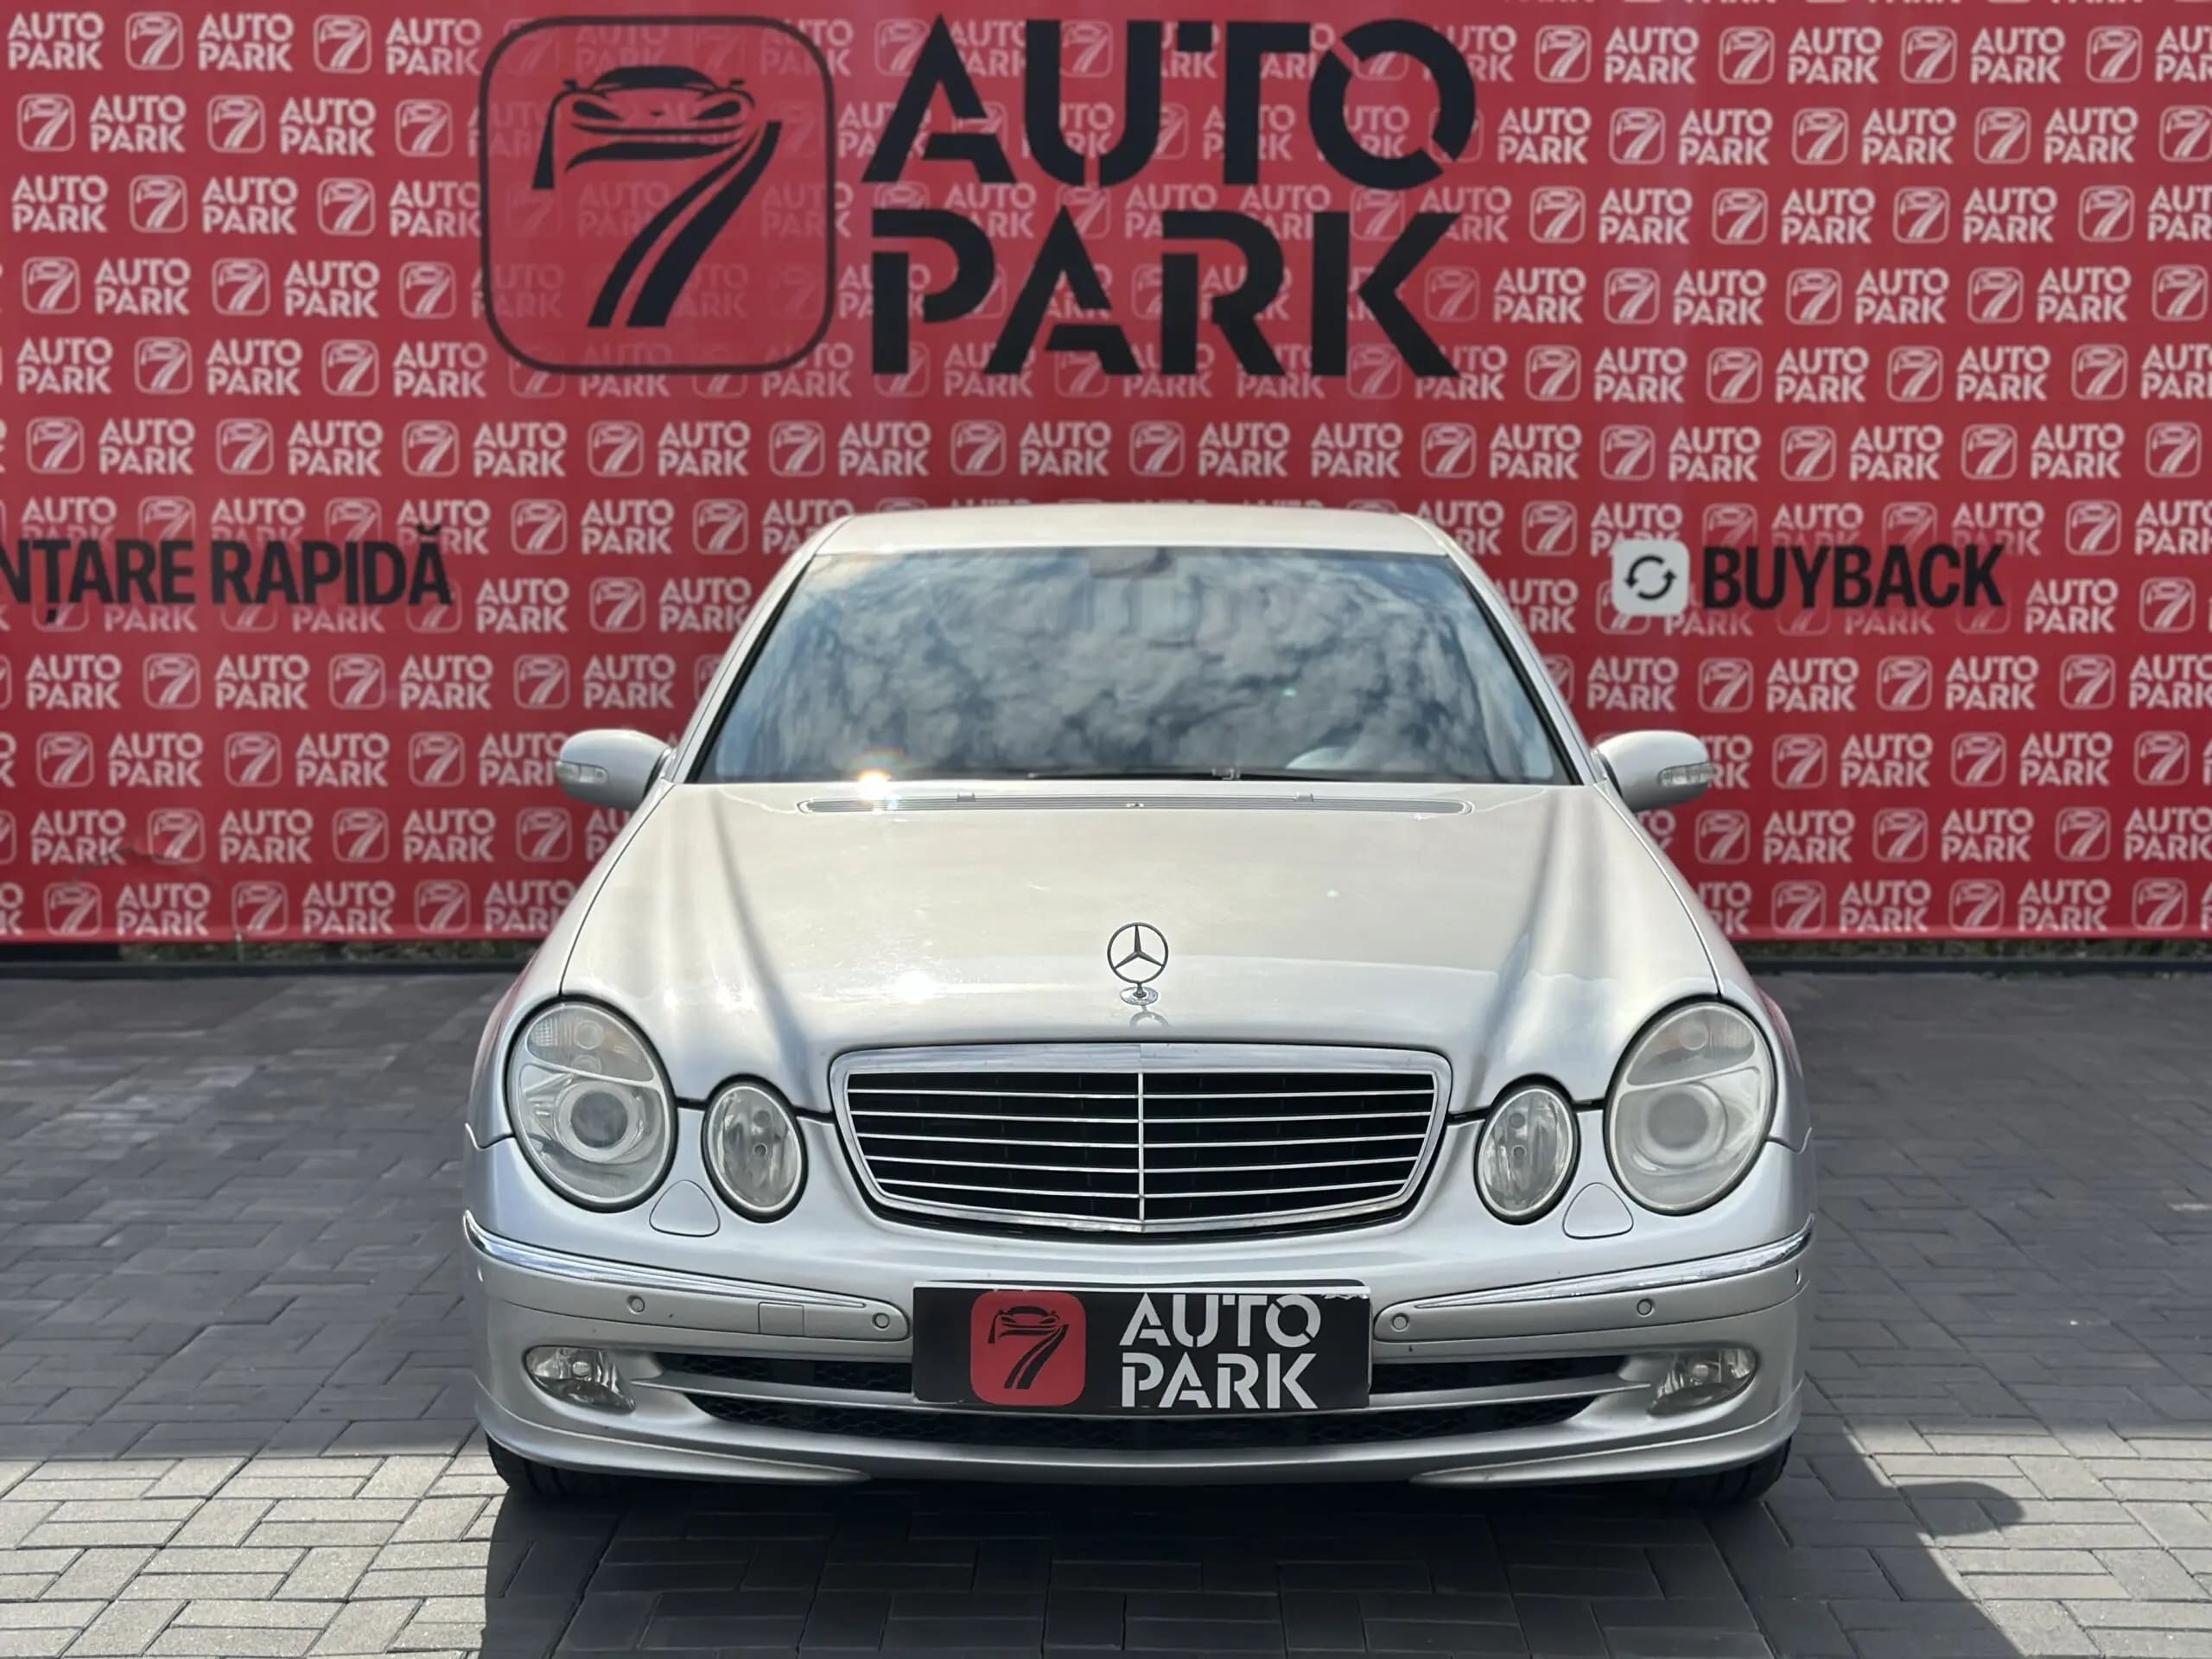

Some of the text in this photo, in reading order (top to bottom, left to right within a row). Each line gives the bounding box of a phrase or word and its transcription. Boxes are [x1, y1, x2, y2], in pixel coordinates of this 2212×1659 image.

[8, 12, 104, 41] AUTO
[198, 14, 294, 41] AUTO
[386, 18, 481, 46] AUTO
[1605, 27, 1700, 54] AUTO
[1789, 27, 1883, 54] AUTO
[1972, 27, 2065, 54] AUTO
[9, 41, 102, 69] PARK
[199, 41, 292, 71] PARK
[386, 46, 478, 74] PARK
[1605, 54, 1695, 84] PARK
[1788, 54, 1878, 83] PARK
[1971, 54, 2061, 83] PARK
[90, 95, 187, 123] AUTO
[280, 97, 376, 124] AUTO
[861, 14, 1477, 191] AUTO
[1498, 107, 1591, 135] AUTO
[1680, 109, 1773, 136] AUTO
[1862, 108, 1956, 136] AUTO
[2045, 106, 2139, 134] AUTO
[91, 123, 184, 152] PARK
[281, 124, 373, 156] PARK
[1498, 135, 1587, 163] PARK
[1679, 136, 1768, 165] PARK
[1862, 136, 1953, 164] PARK
[2044, 134, 2134, 163] PARK
[12, 175, 108, 203] AUTO
[202, 177, 298, 204] AUTO
[390, 181, 480, 208] AUTO
[944, 183, 1036, 210] AUTO
[1599, 188, 1693, 215] AUTO
[1783, 188, 1875, 215] AUTO
[1964, 187, 2057, 214] AUTO
[13, 203, 106, 232] PARK
[203, 204, 296, 234] PARK
[390, 208, 480, 237] PARK
[1599, 215, 1688, 244] PARK
[1782, 215, 1872, 244] PARK
[1963, 214, 2053, 243] PARK
[95, 258, 190, 285] AUTO
[284, 261, 380, 288] AUTO
[1495, 268, 1586, 295] AUTO
[1674, 270, 1766, 296] AUTO
[1856, 268, 1949, 295] AUTO
[2038, 266, 2132, 294] AUTO
[95, 285, 189, 315] PARK
[285, 288, 378, 318] PARK
[872, 205, 1461, 378] PARK
[1494, 295, 1582, 323] PARK
[1673, 296, 1762, 325] PARK
[1855, 295, 1945, 323] PARK
[2037, 294, 2126, 322] PARK
[16, 337, 113, 365] AUTO
[207, 339, 302, 365] AUTO
[393, 341, 487, 369] AUTO
[1595, 347, 1688, 373] AUTO
[1777, 346, 1870, 374] AUTO
[1957, 346, 2050, 372] AUTO
[17, 365, 111, 394] PARK
[207, 365, 300, 396] PARK
[394, 369, 485, 397] PARK
[1594, 373, 1683, 403] PARK
[1776, 374, 1865, 403] PARK
[1956, 372, 2046, 401] PARK
[99, 418, 195, 445] AUTO
[288, 421, 383, 447] AUTO
[474, 422, 567, 448] AUTO
[658, 422, 750, 448] AUTO
[839, 422, 931, 448] AUTO
[1020, 422, 1111, 448] AUTO
[1198, 423, 1290, 448] AUTO
[1312, 423, 1402, 449] AUTO
[1491, 424, 1582, 450] AUTO
[1669, 427, 1761, 453] AUTO
[1850, 425, 1943, 452] AUTO
[2032, 423, 2125, 450] AUTO
[99, 445, 193, 474] PARK
[289, 447, 380, 476] PARK
[474, 448, 564, 477] PARK
[658, 448, 747, 476] PARK
[839, 448, 927, 476] PARK
[1020, 448, 1108, 475] PARK
[1198, 448, 1287, 476] PARK
[1312, 449, 1400, 477] PARK
[1490, 450, 1578, 479] PARK
[1669, 453, 1758, 481] PARK
[1850, 452, 1939, 480] PARK
[2031, 450, 2120, 479] PARK
[22, 497, 117, 524] AUTO
[211, 498, 306, 525] AUTO
[397, 499, 491, 526] AUTO
[581, 499, 674, 525] AUTO
[1953, 501, 2044, 529] AUTO
[582, 525, 671, 554] PARK
[212, 524, 452, 606] RAPIDĂ
[1703, 543, 2005, 609] BUYBACK
[476, 578, 569, 605] AUTO
[2027, 578, 2119, 606] AUTO
[105, 605, 194, 632] PARK
[292, 606, 385, 632] PARK
[476, 605, 567, 632] PARK
[2025, 606, 2114, 633] PARK
[27, 654, 122, 681] AUTO
[215, 654, 309, 681] AUTO
[400, 654, 493, 681] AUTO
[583, 654, 676, 681] AUTO
[1588, 657, 1679, 683] AUTO
[1767, 657, 1859, 683] AUTO
[1947, 656, 2039, 682] AUTO
[27, 681, 120, 709] PARK
[216, 681, 308, 709] PARK
[400, 681, 491, 709] PARK
[584, 681, 673, 709] PARK
[1587, 683, 1675, 712] PARK
[1767, 683, 1855, 711] PARK
[1946, 682, 2035, 709] PARK
[2129, 681, 2212, 709] PARK
[109, 733, 203, 759] AUTO
[296, 733, 390, 760] AUTO
[1841, 733, 1933, 760] AUTO
[2020, 732, 2113, 758] AUTO
[109, 759, 201, 787] PARK
[296, 760, 387, 786] PARK
[1840, 760, 1929, 787] PARK
[2020, 758, 2108, 785] PARK
[31, 809, 126, 836] AUTO
[219, 810, 314, 836] AUTO
[404, 808, 496, 835] AUTO
[1764, 809, 1855, 836] AUTO
[1942, 808, 2034, 834] AUTO
[2125, 807, 2212, 833] AUTO
[31, 836, 124, 865] PARK
[220, 836, 311, 862] PARK
[404, 835, 493, 862] PARK
[1764, 836, 1852, 863] PARK
[1942, 834, 2031, 861] PARK
[2125, 833, 2212, 861] PARK
[117, 883, 210, 909] AUTO
[302, 880, 395, 907] AUTO
[1840, 880, 1931, 906] AUTO
[2018, 879, 2111, 905] AUTO
[116, 909, 209, 938] PARK
[302, 907, 394, 936] PARK
[1839, 906, 1929, 934] PARK
[2017, 905, 2108, 933] PARK
[1119, 1292, 1321, 1348] AUTO
[1122, 1352, 1318, 1409] PARK
